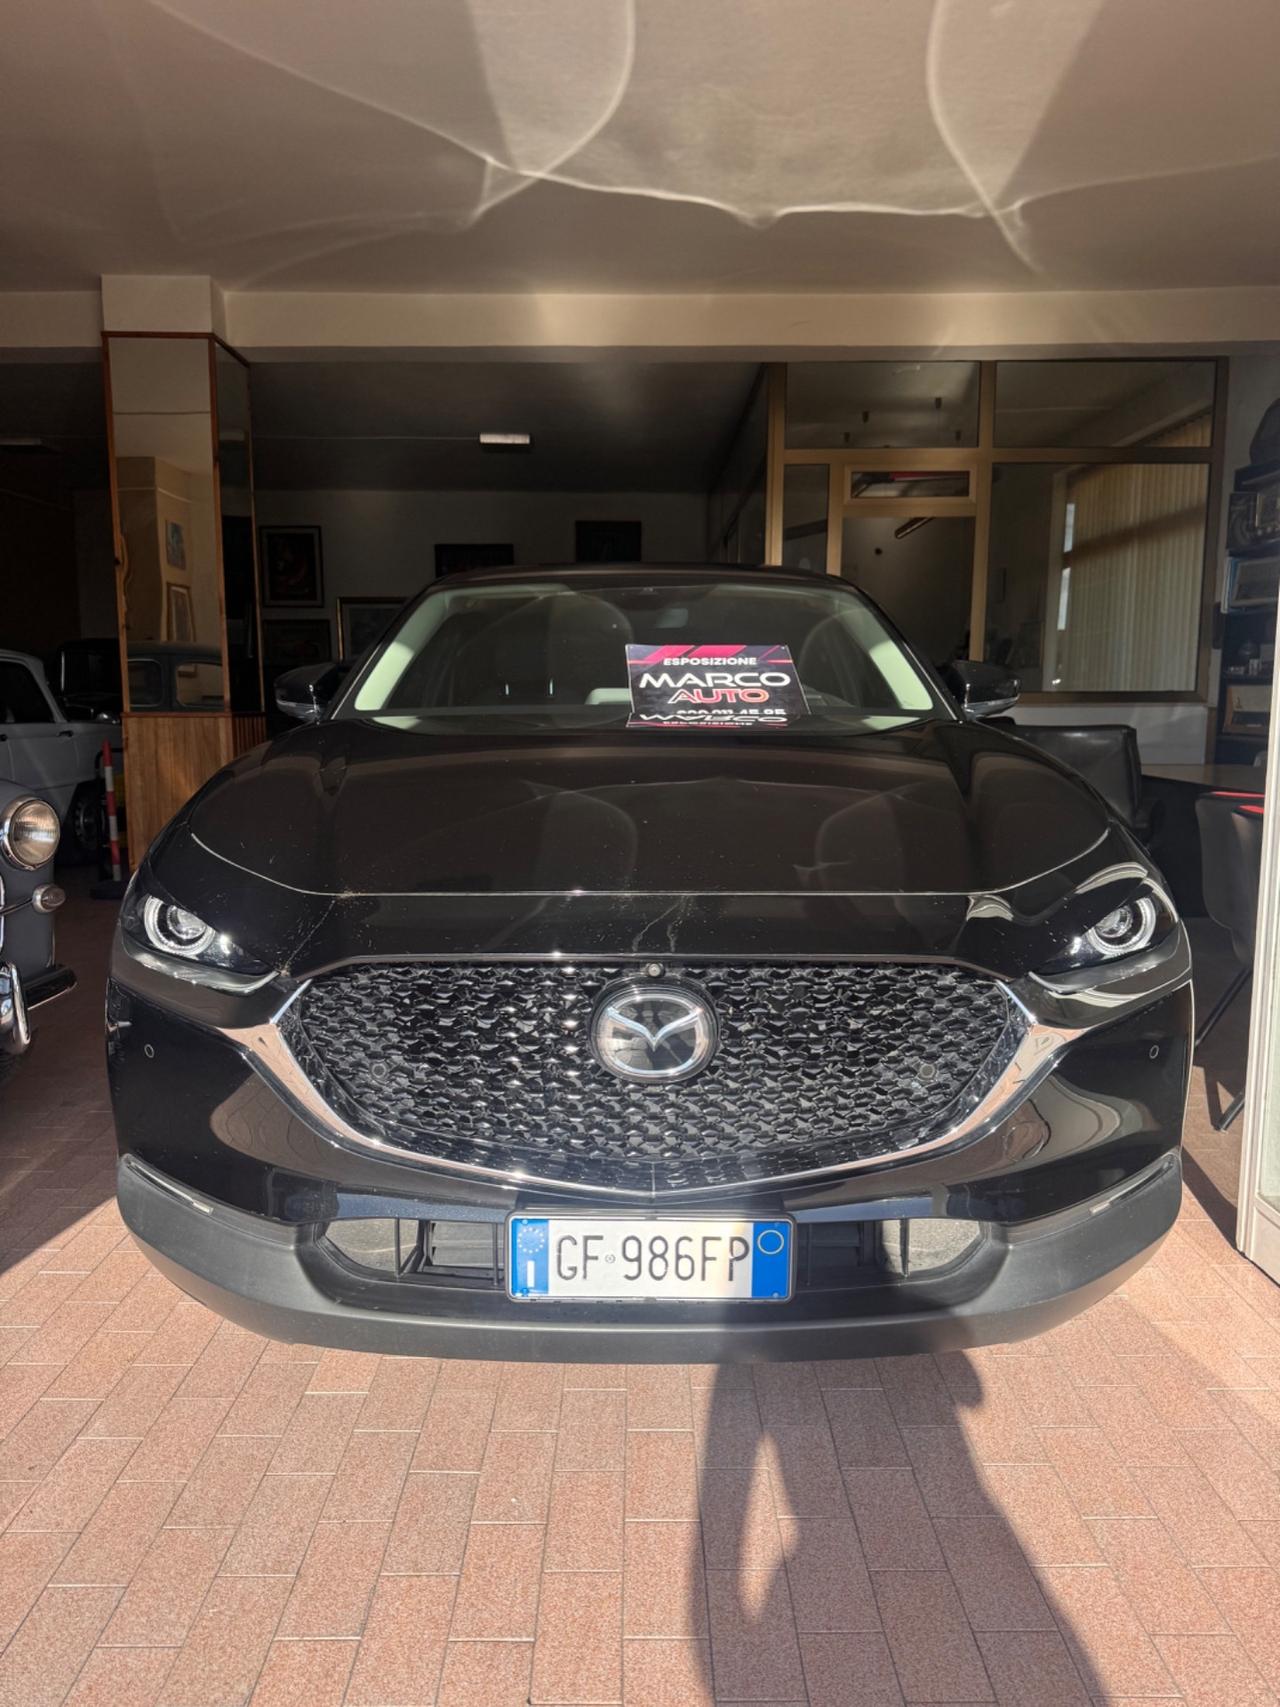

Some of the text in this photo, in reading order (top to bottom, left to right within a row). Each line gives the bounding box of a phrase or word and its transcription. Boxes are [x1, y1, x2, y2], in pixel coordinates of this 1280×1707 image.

[663, 657, 757, 666] ESPOSIZIONE
[639, 672, 791, 689] MARCO
[667, 688, 770, 704] AUTO
